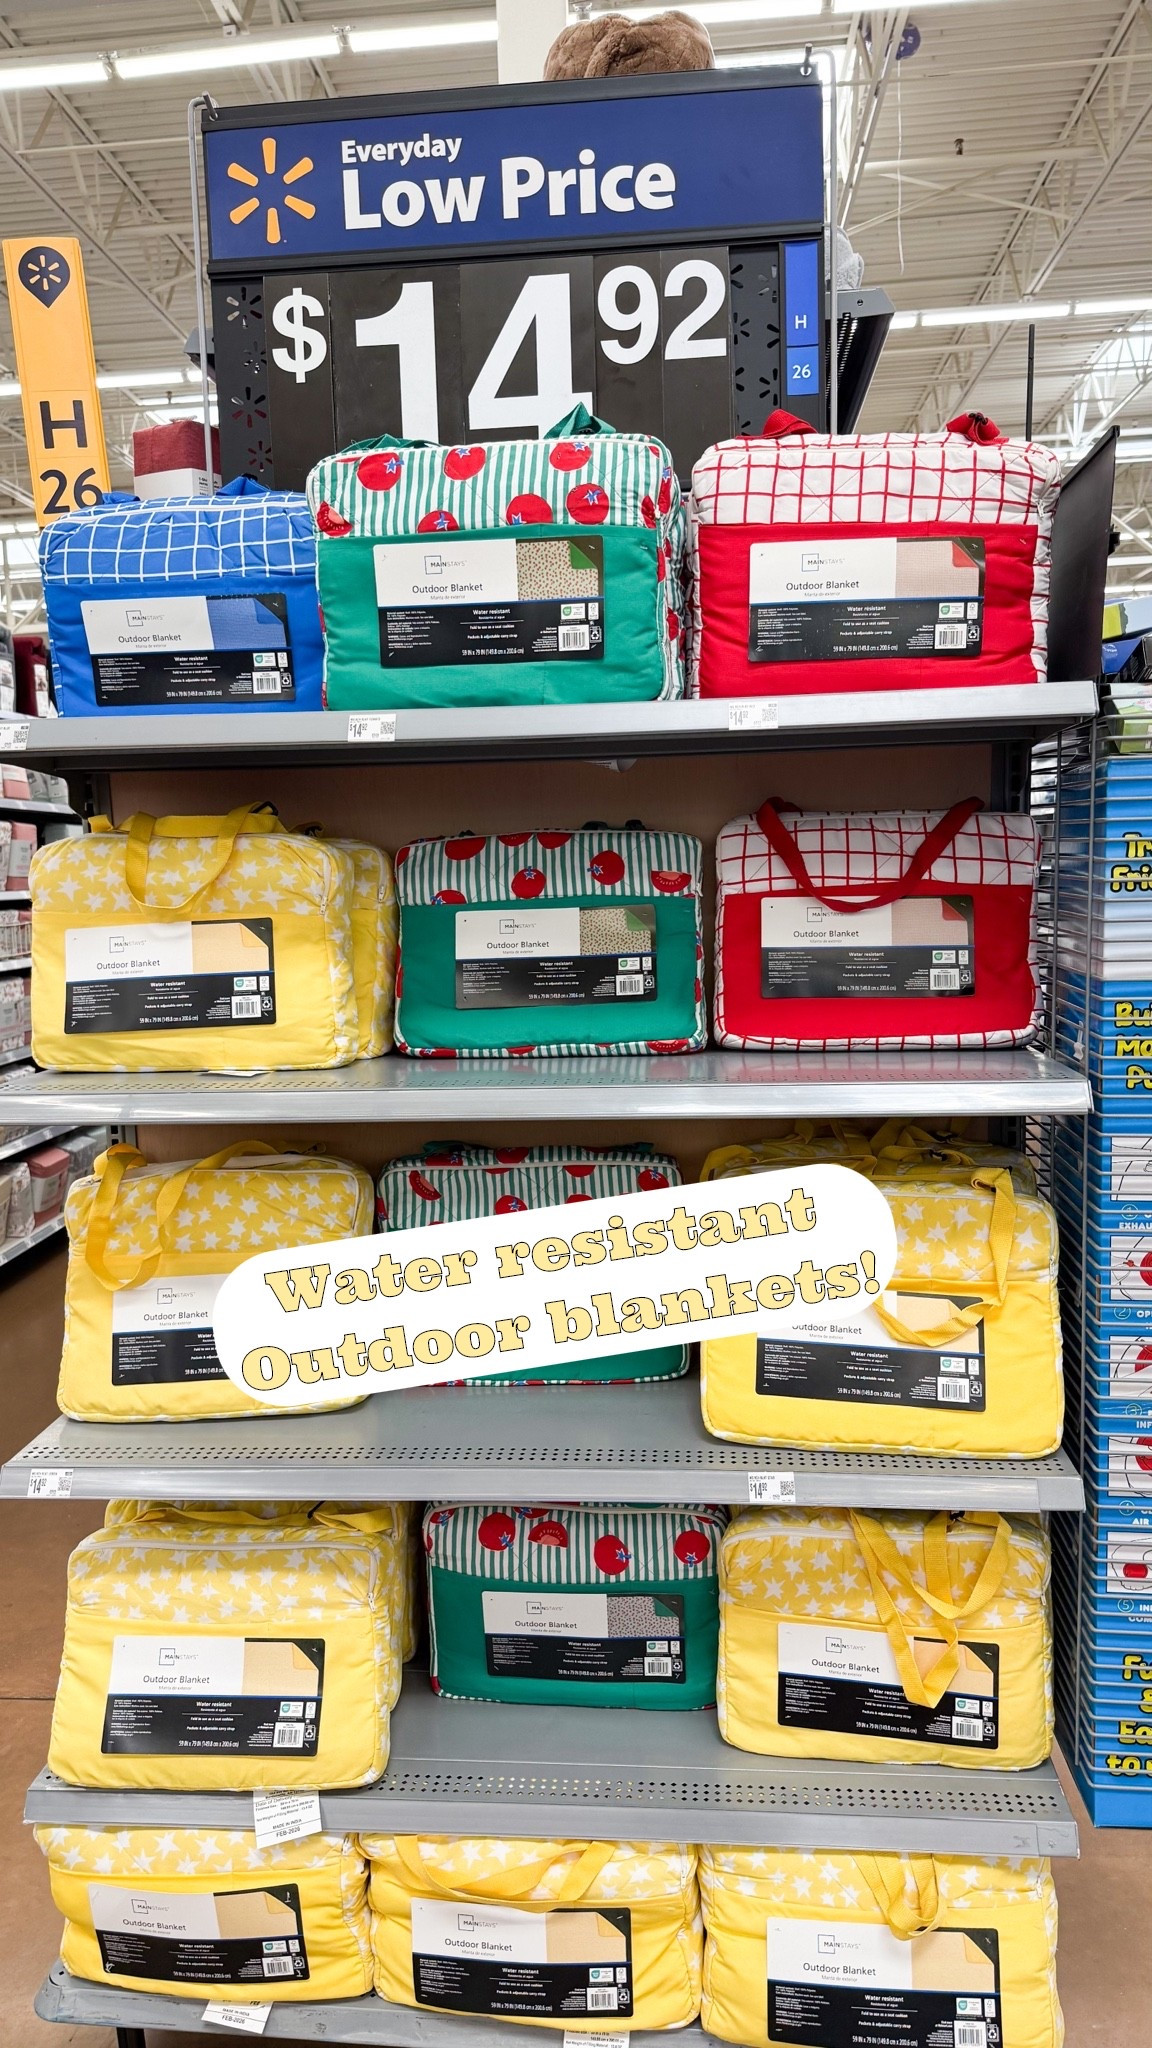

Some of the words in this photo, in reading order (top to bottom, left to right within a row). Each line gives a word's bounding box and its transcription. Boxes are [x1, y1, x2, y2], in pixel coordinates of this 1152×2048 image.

[341, 133, 462, 167] Everyday
[342, 168, 486, 231] Low
[501, 148, 676, 219] Price
[795, 314, 807, 328] H
[272, 288, 328, 383] $
[355, 272, 594, 442] 14
[597, 259, 727, 365] 92
[792, 364, 812, 379] 26
[40, 400, 87, 449] H
[40, 467, 103, 514] 26
[412, 585, 448, 593] Outdoor
[451, 583, 483, 592] Blanket
[786, 582, 823, 591] Outdoor
[826, 580, 859, 589] Blanket
[118, 635, 150, 643] Outdoor
[153, 634, 181, 642] Blanket
[1110, 864, 1152, 892] Fri
[793, 930, 826, 938] Outdoor
[97, 961, 128, 969] Outdoor
[131, 959, 160, 967] Blanket
[1115, 1001, 1152, 1028] Bu
[144, 1312, 176, 1321] Outdoor
[178, 1311, 208, 1319] Blanket
[830, 1325, 862, 1334] Blanket
[831, 1643, 864, 1651] MAINSTAYS
[811, 1659, 846, 1670] Outdoor
[848, 1663, 879, 1673] Blanket
[143, 1676, 177, 1684] Outdoor
[180, 1676, 210, 1684] Blanket
[1107, 1753, 1141, 1777] to
[123, 1919, 155, 1928] Outdoor
[157, 1922, 186, 1931] Blanket
[464, 1920, 497, 1928] MAINSTAYS
[445, 1938, 479, 1949] Outdoor
[481, 1942, 512, 1952] Blanket
[824, 1941, 859, 1949] MAINSTAYS
[803, 1963, 840, 1973] Outdoor
[842, 1965, 876, 1976] Blanket
